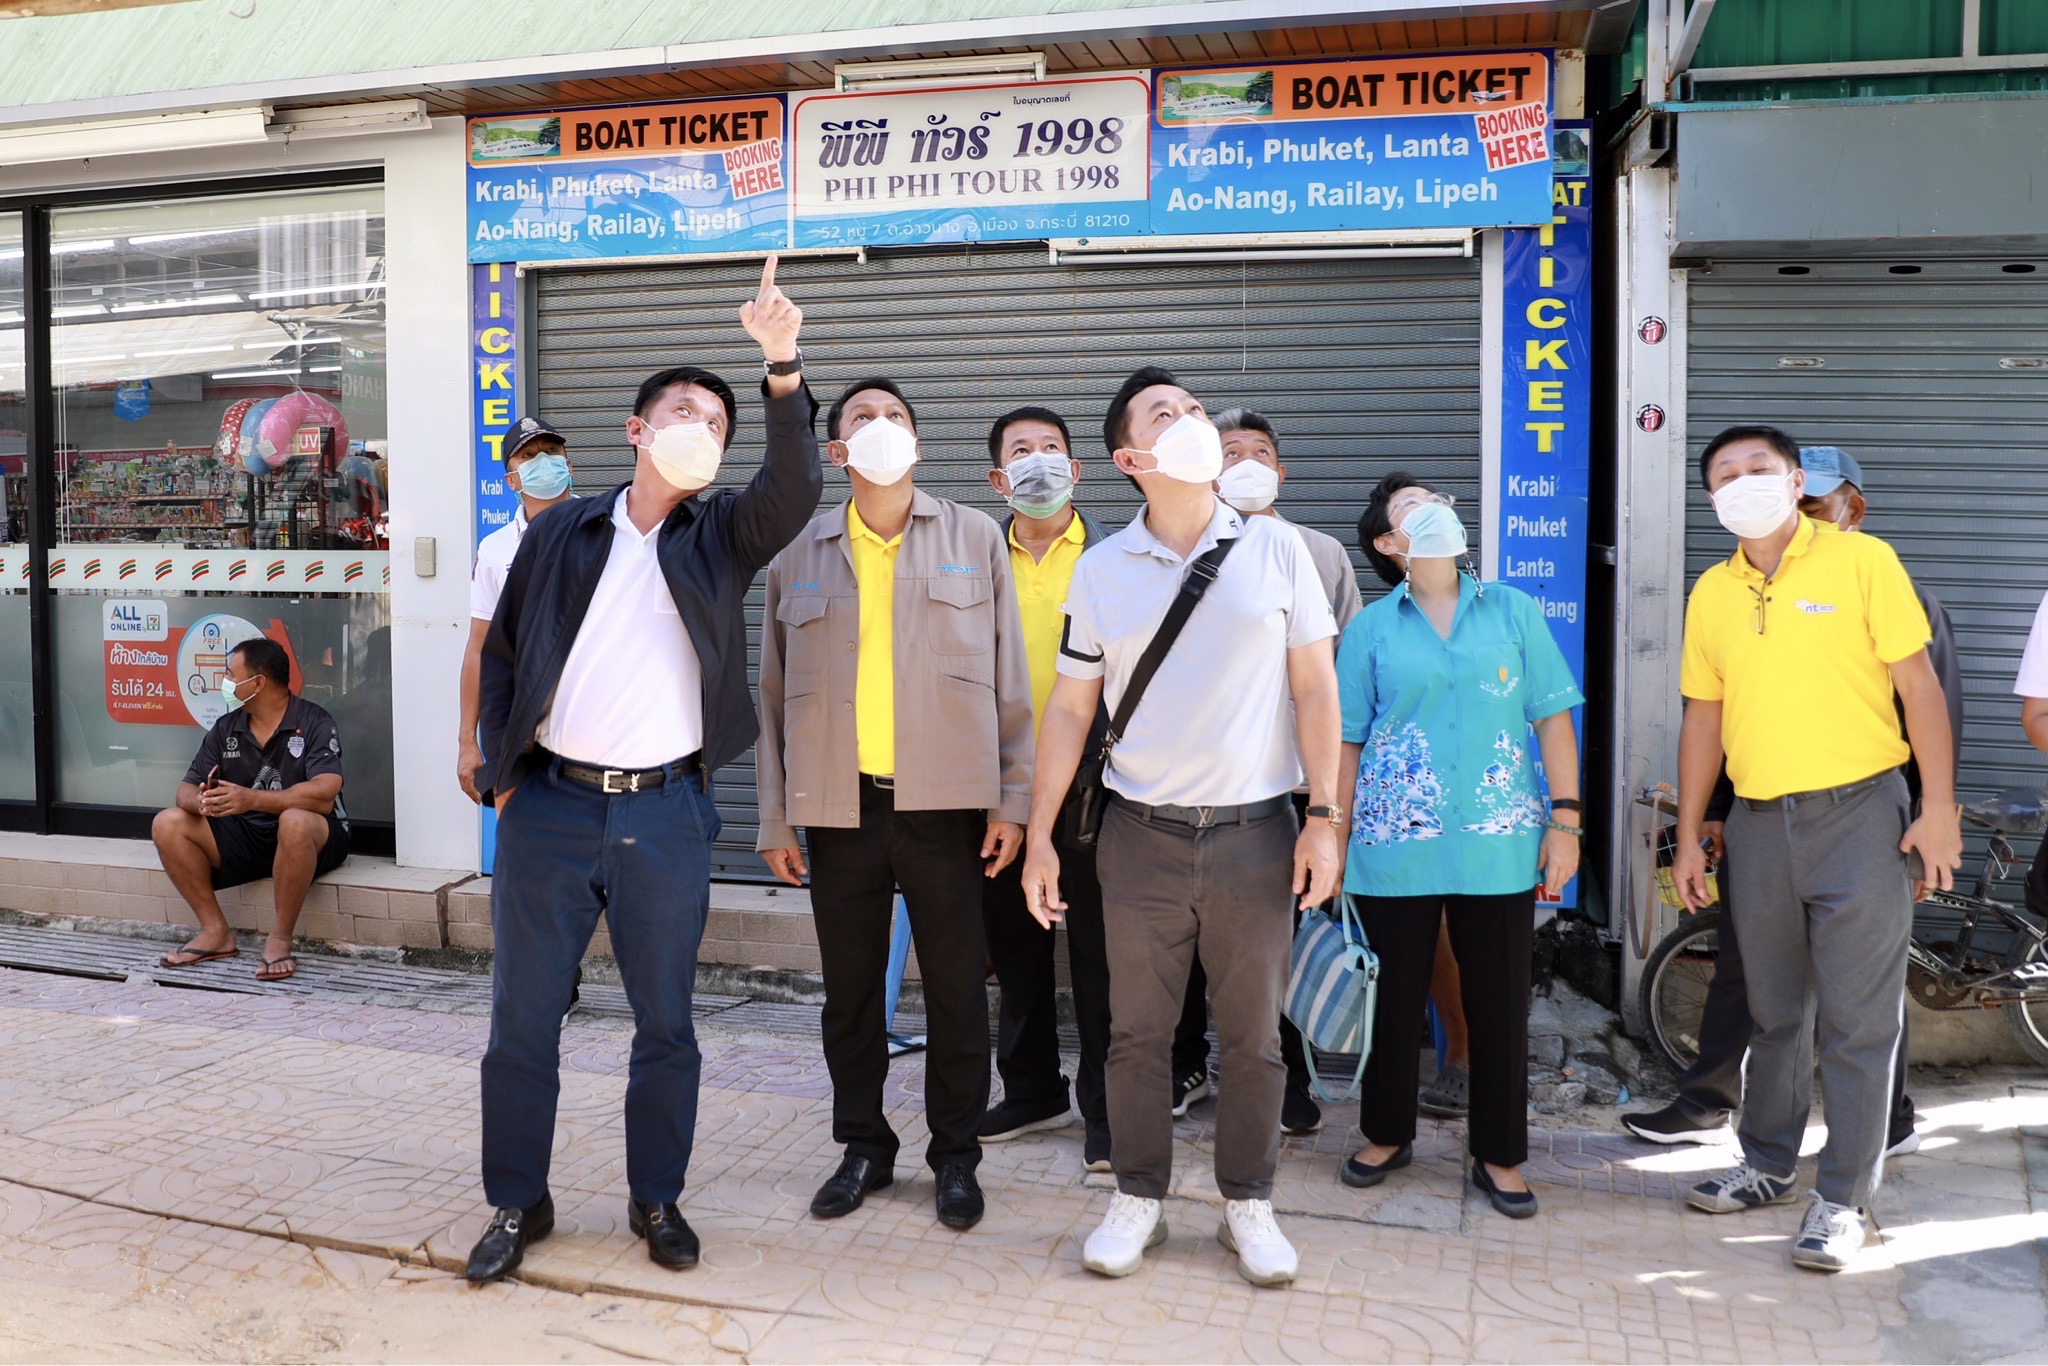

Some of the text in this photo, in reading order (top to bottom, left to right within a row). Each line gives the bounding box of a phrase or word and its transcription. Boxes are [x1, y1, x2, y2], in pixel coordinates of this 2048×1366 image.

[1292, 67, 1531, 110] BOAT TICKET
[576, 110, 769, 151] BOAT TICKET
[1478, 104, 1547, 139] BOOKING
[725, 139, 781, 172] BOOKING
[818, 110, 1125, 168] พีพี ทัวร์ 1998
[1168, 132, 1470, 170] Krabi, Phuket, Lanta
[1485, 133, 1548, 170] HERE
[475, 168, 718, 205] Krabi, Phuket, Lanta
[732, 163, 782, 199] HERE
[824, 165, 1120, 202] PHI PHI TOUR 1998
[1167, 177, 1498, 214] Ao-Nang, Railay, Lipeh
[1553, 182, 1586, 206] AT
[475, 207, 742, 244] Ao-Nang, Railay, Lipeh
[820, 225, 840, 240] 52
[873, 224, 882, 236] 7
[967, 216, 1019, 234] อ.เมือง
[1025, 210, 1077, 231] จ.กระบี่
[1084, 213, 1130, 228] 81210
[481, 479, 503, 496] Krabi
[1508, 475, 1555, 497] Krabi
[482, 508, 511, 525] Phuket
[1507, 515, 1567, 538] Phuket
[1506, 556, 1555, 577] Lanta
[111, 605, 141, 621] ALL
[1534, 596, 1578, 624] Nang
[111, 623, 141, 631] ONLINE
[112, 678, 143, 696] รับได้
[146, 682, 164, 697] 24
